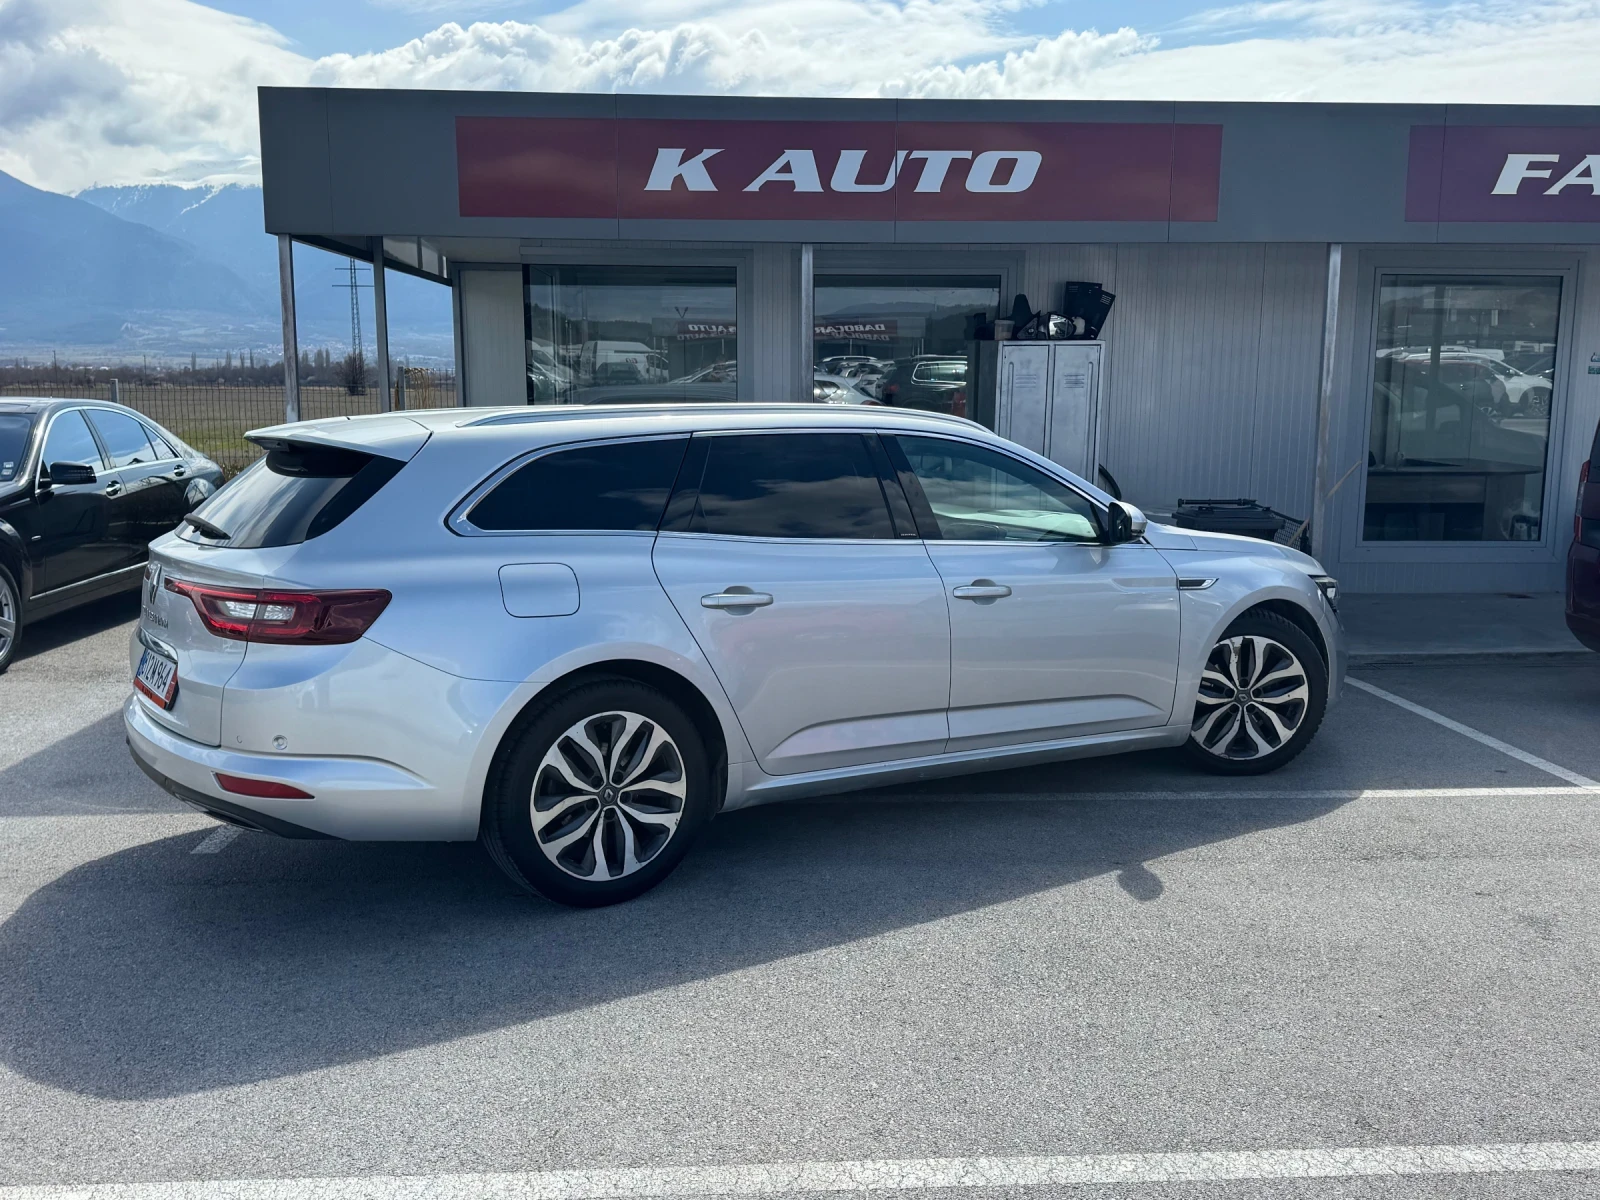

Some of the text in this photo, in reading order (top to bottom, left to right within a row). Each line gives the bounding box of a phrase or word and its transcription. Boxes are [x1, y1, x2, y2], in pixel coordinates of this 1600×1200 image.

[643, 147, 1043, 193] K AUTO
[1490, 153, 1600, 196] FA
